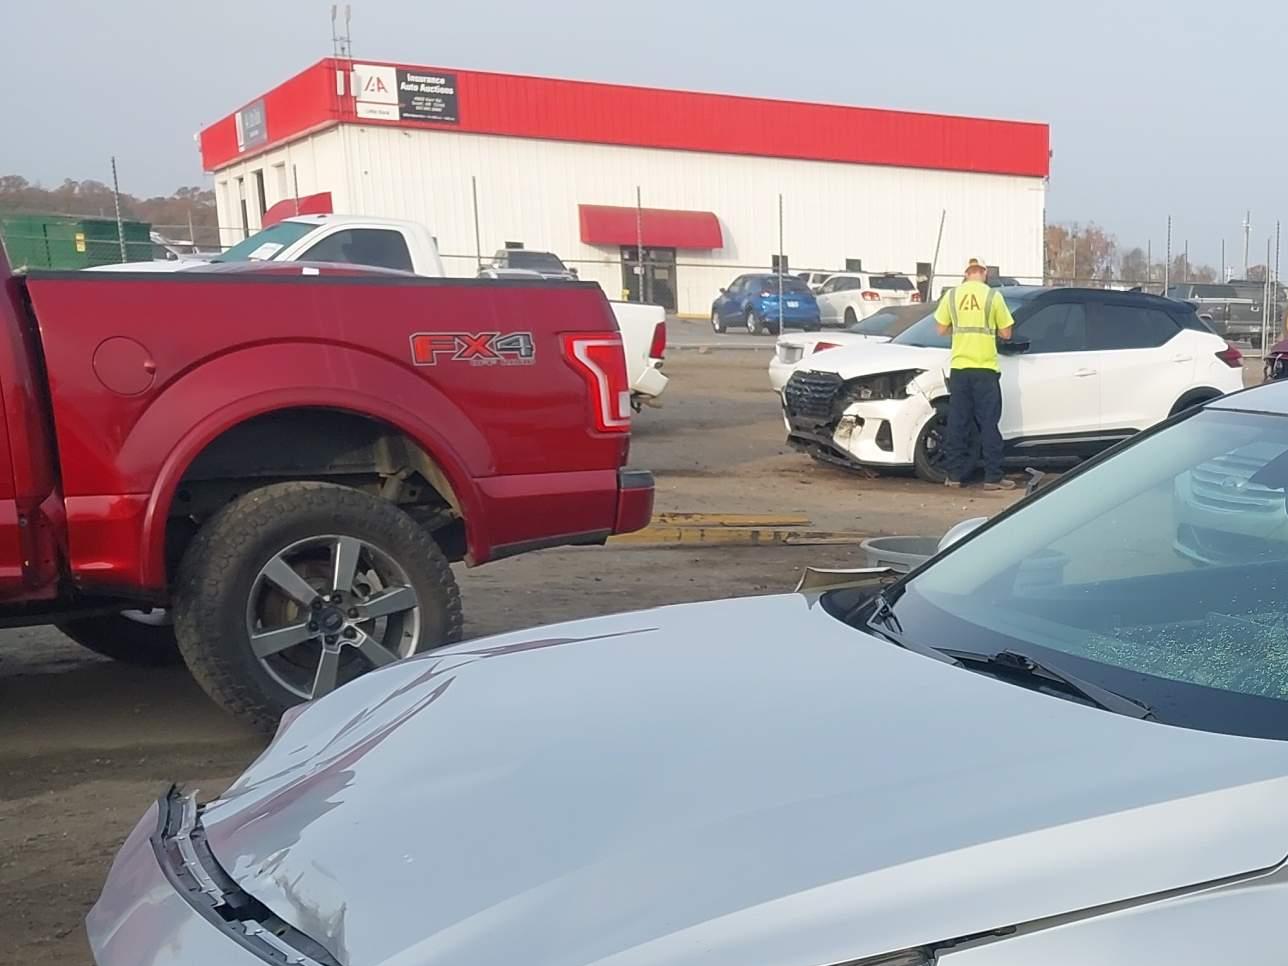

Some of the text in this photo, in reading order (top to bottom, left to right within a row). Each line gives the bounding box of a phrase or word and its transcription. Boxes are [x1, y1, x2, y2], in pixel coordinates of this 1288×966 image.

[407, 73, 445, 85] Insurance
[400, 82, 454, 95] Auto Auctions
[409, 332, 535, 366] FX4
